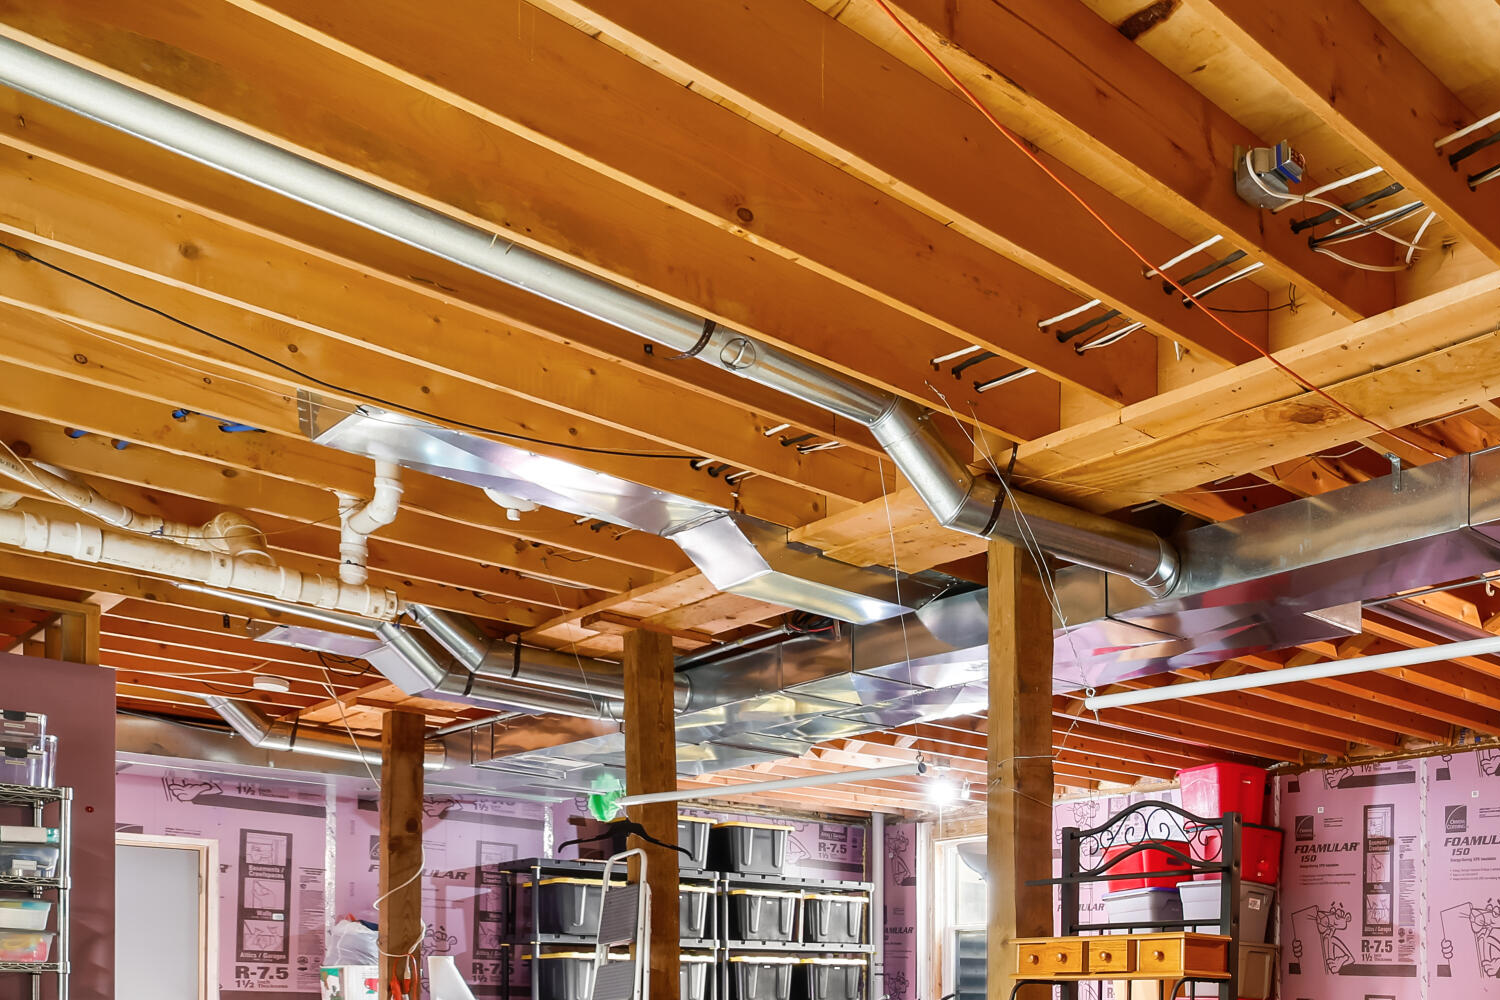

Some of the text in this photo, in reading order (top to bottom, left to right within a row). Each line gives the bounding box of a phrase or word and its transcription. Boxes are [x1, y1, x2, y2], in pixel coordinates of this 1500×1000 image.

[818, 842, 847, 854] R-7.5
[1294, 841, 1358, 854] FOAMULAR
[1452, 847, 1471, 856] 150
[1361, 939, 1393, 953] R-7.5
[235, 965, 289, 980] R-7.5
